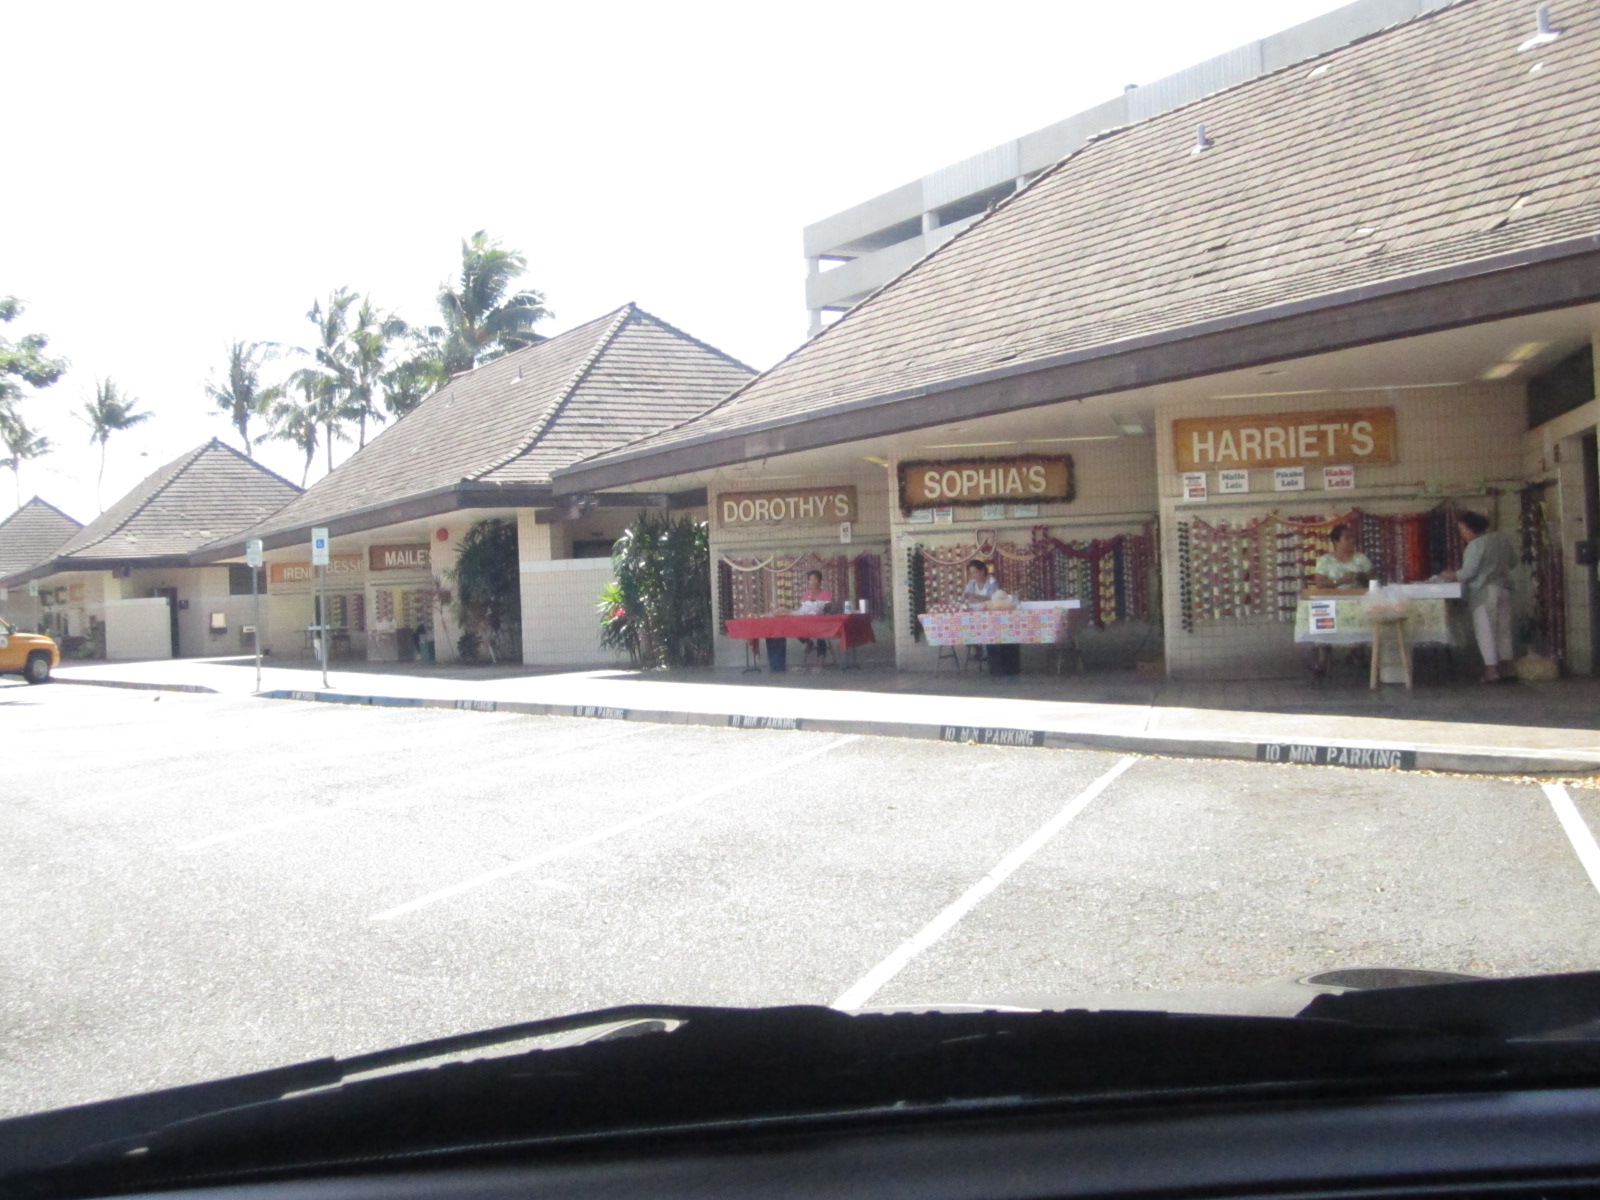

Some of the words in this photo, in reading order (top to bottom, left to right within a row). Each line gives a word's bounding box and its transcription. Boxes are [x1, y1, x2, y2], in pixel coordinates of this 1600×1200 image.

[1192, 421, 1375, 464] HARRIET'S
[924, 465, 1047, 498] SOPHIA'S
[723, 494, 849, 522] DOROTHY'S
[384, 549, 432, 566] MAILE'
[760, 716, 796, 730] PARKING
[945, 727, 956, 740] 10
[984, 729, 1034, 746] PARKING
[1265, 744, 1281, 762] 10
[1288, 746, 1317, 763] MIN
[1326, 747, 1402, 767] PARKING
